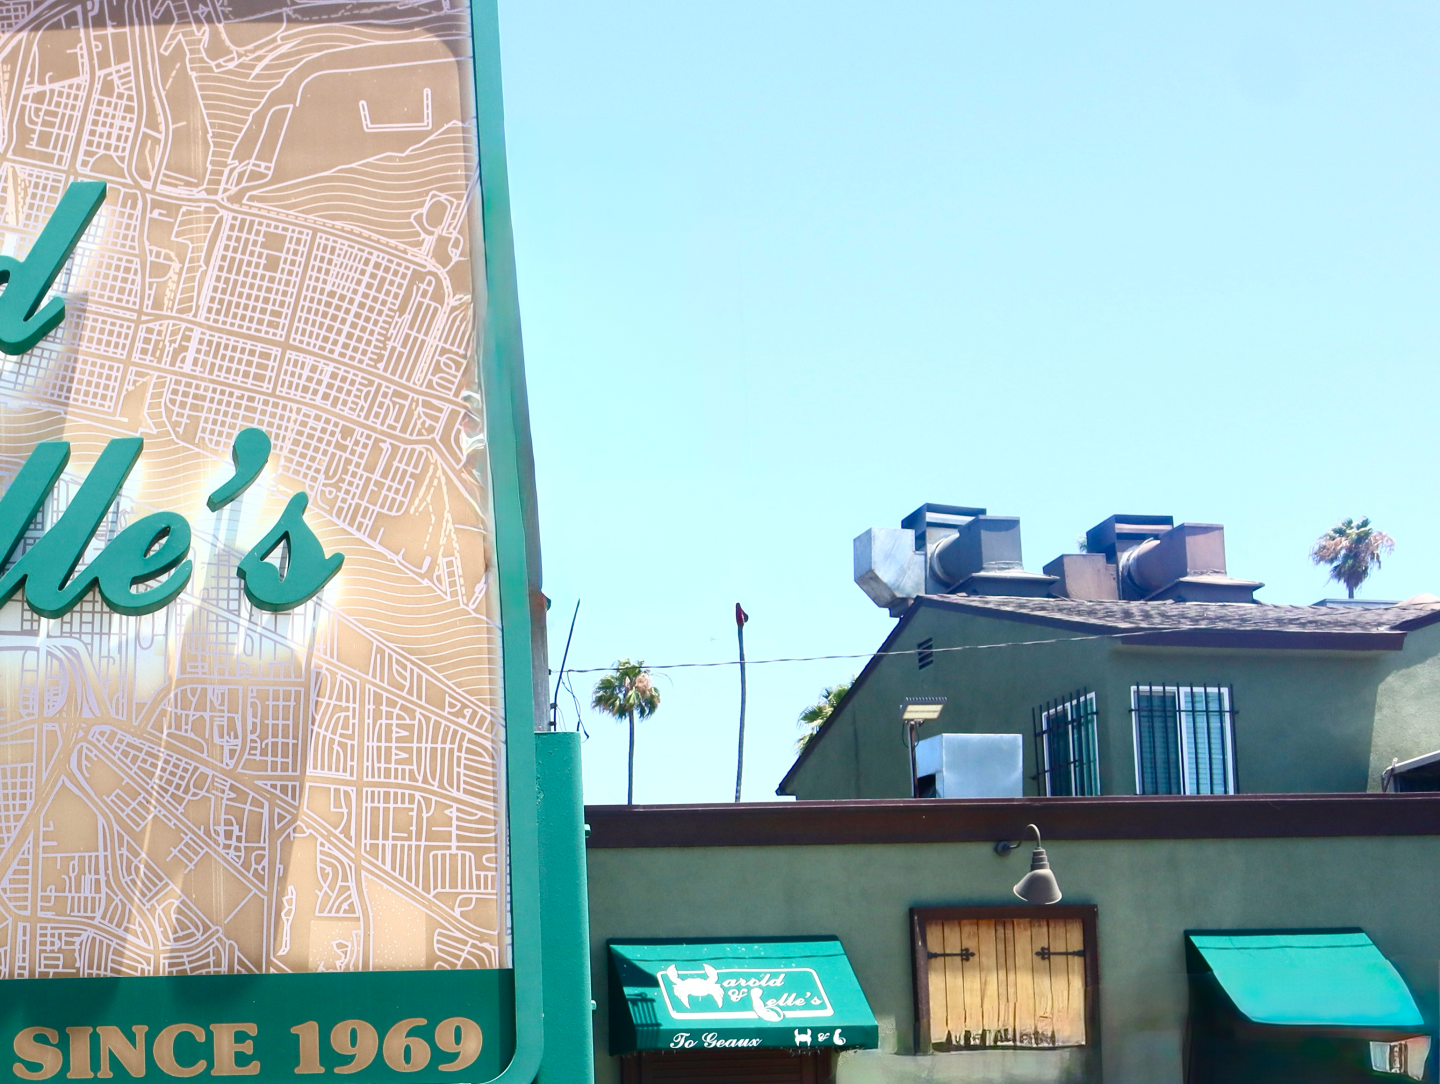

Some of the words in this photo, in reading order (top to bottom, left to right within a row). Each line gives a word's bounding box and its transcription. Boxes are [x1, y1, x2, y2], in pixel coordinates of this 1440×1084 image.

[13, 1022, 261, 1081] SINCE
[290, 1016, 484, 1075] 1969
[669, 1032, 699, 1049] To
[701, 1031, 763, 1049] Geaux
